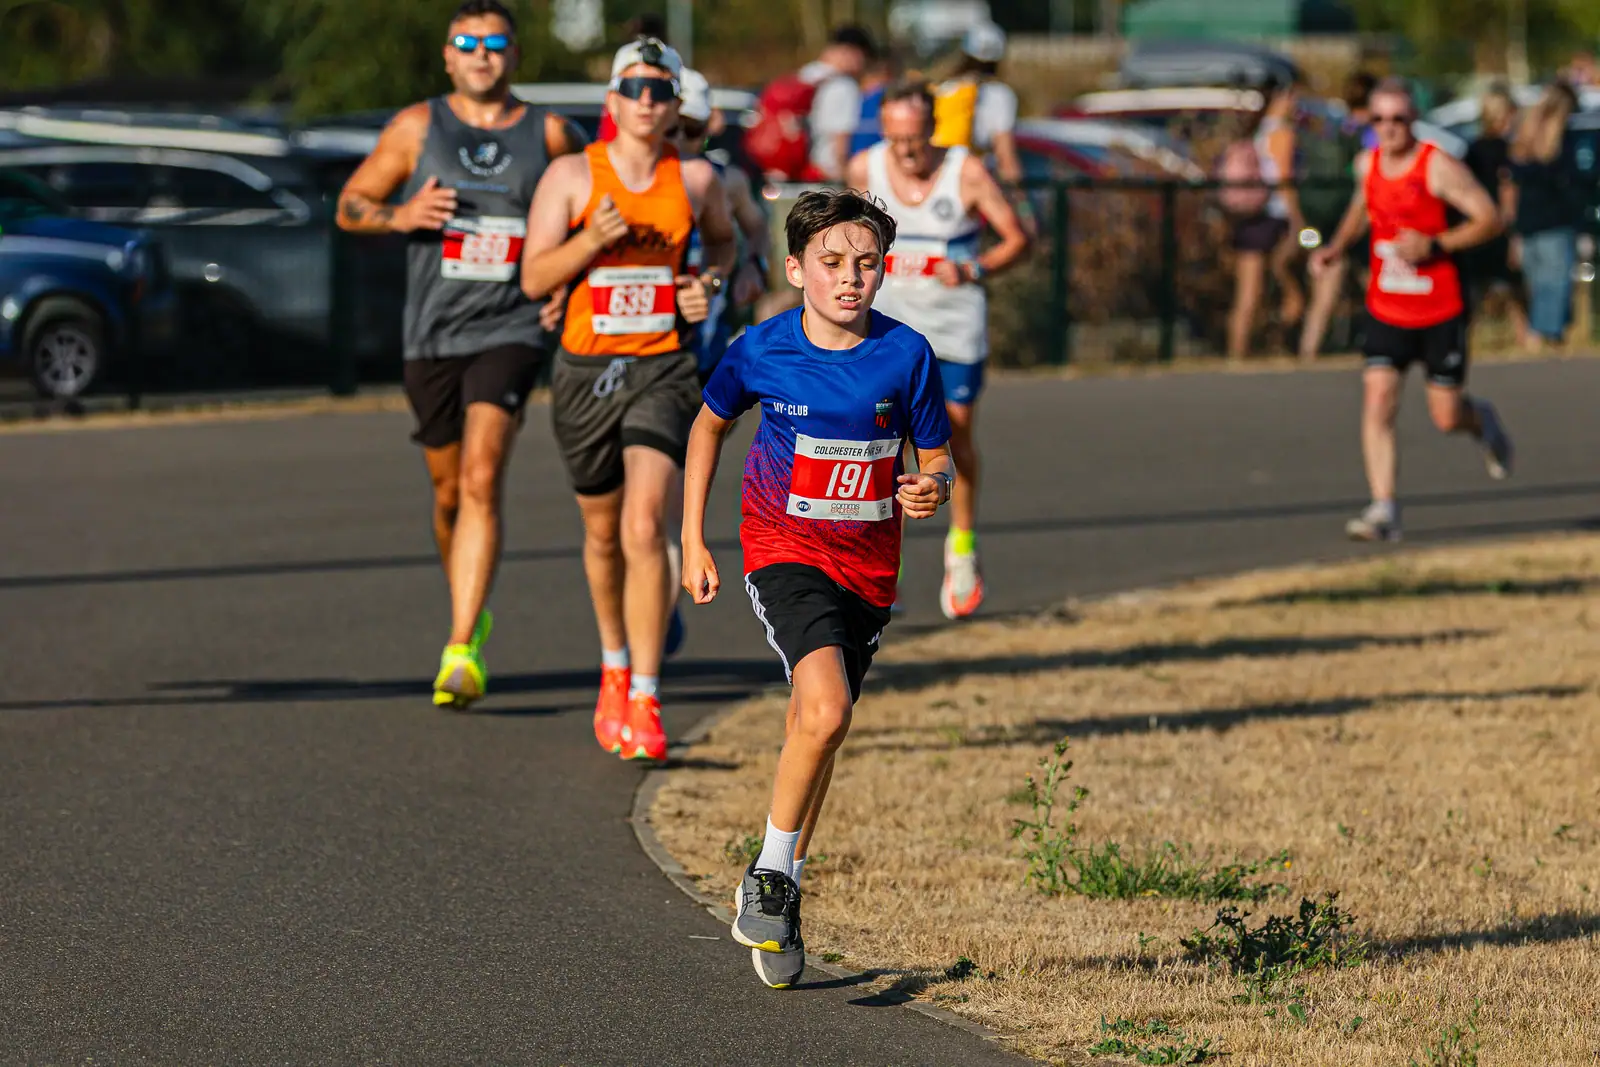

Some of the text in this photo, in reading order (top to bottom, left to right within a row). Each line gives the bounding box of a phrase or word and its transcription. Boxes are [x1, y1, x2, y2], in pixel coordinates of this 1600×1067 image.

[609, 286, 656, 314] 639
[814, 445, 863, 457] COLCHESTER
[875, 445, 883, 454] 5K
[825, 463, 873, 498] 191
